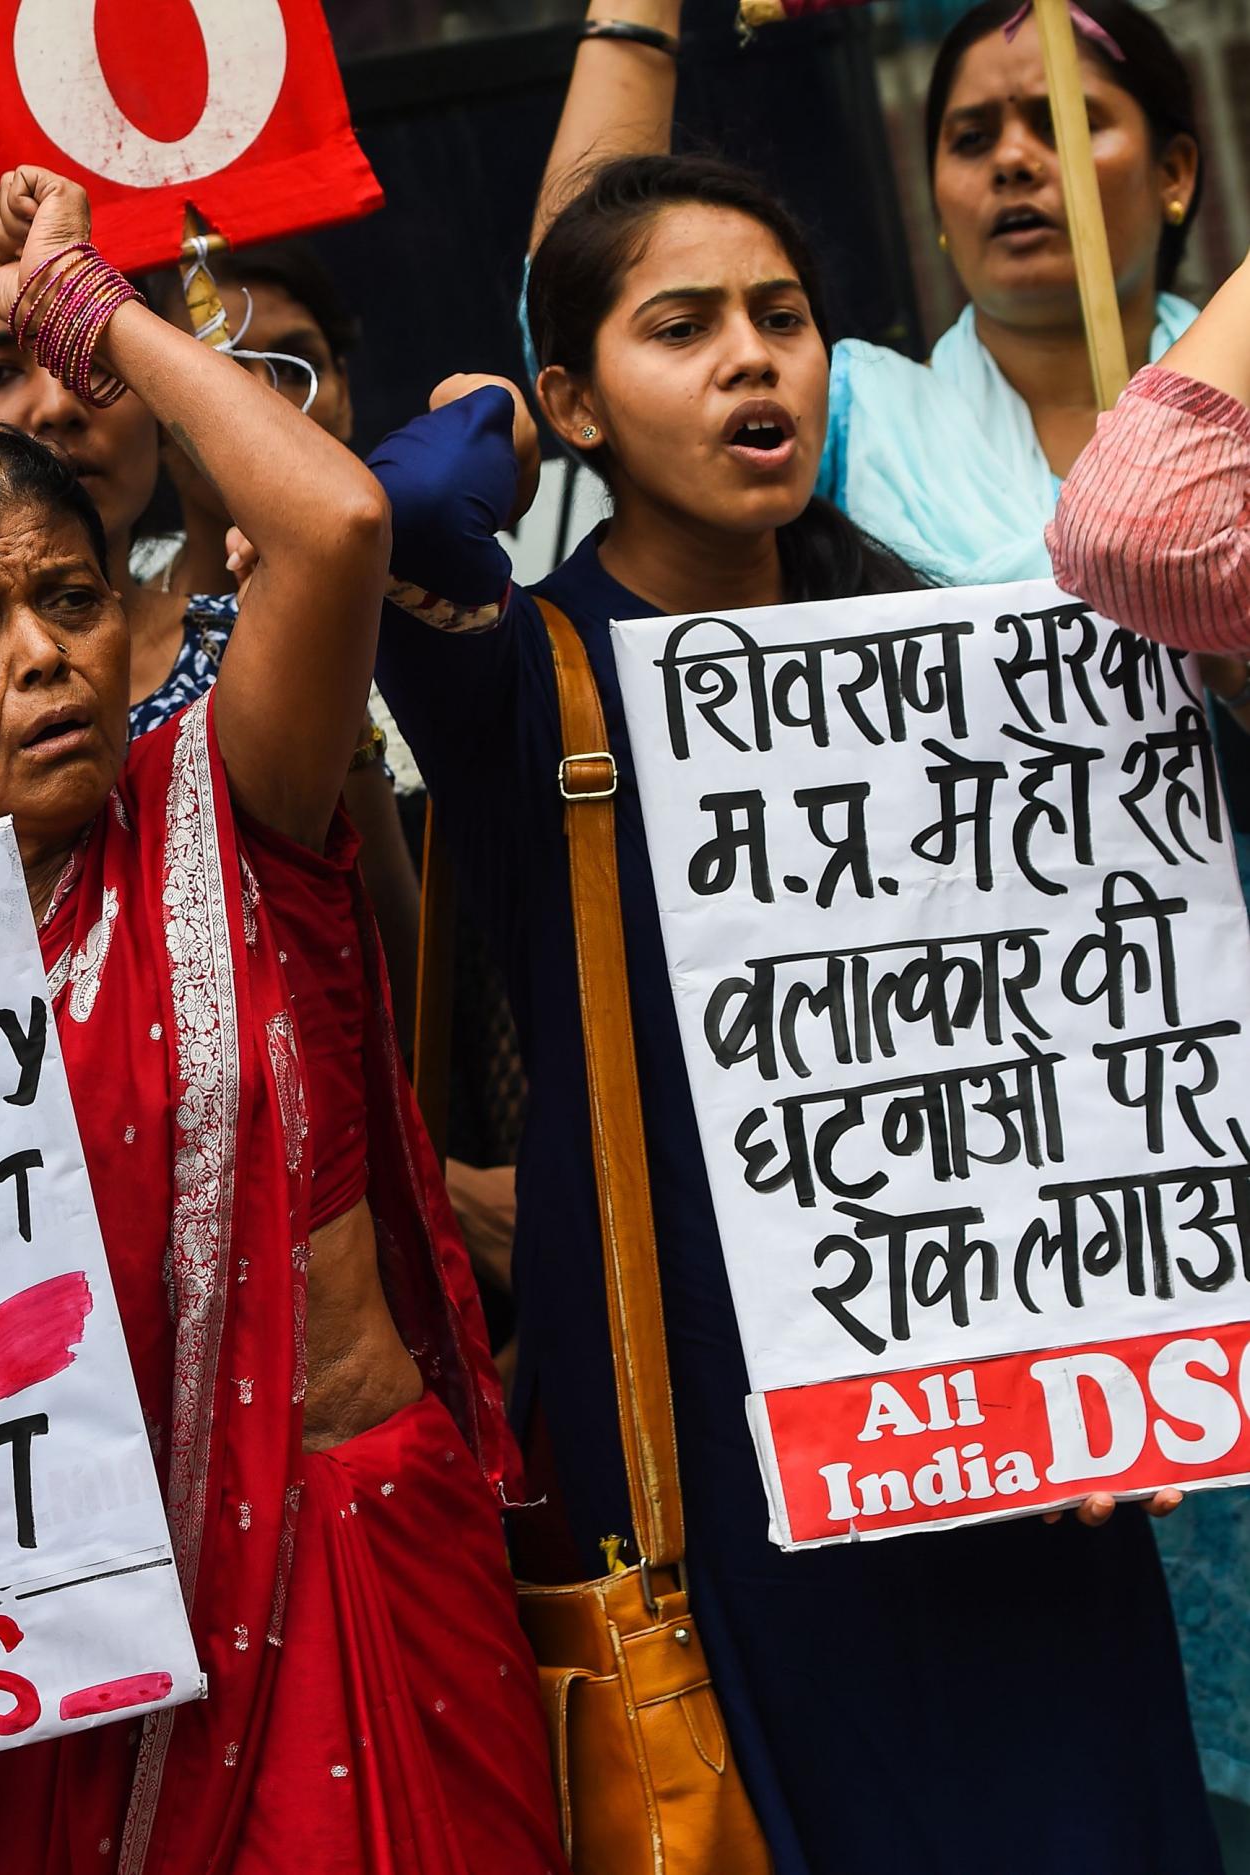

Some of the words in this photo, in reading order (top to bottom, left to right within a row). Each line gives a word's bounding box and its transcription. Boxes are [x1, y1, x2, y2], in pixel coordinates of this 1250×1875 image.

[652, 617, 974, 760] शिवराज
[1118, 705, 1225, 864] रही
[703, 927, 1053, 1081] बलात्कार
[1060, 870, 1188, 1030] की
[1092, 1019, 1242, 1159] पर
[811, 1201, 999, 1356] रोक
[857, 1368, 986, 1442] All
[1029, 1337, 1250, 1485] DS
[817, 1442, 1040, 1522] India
